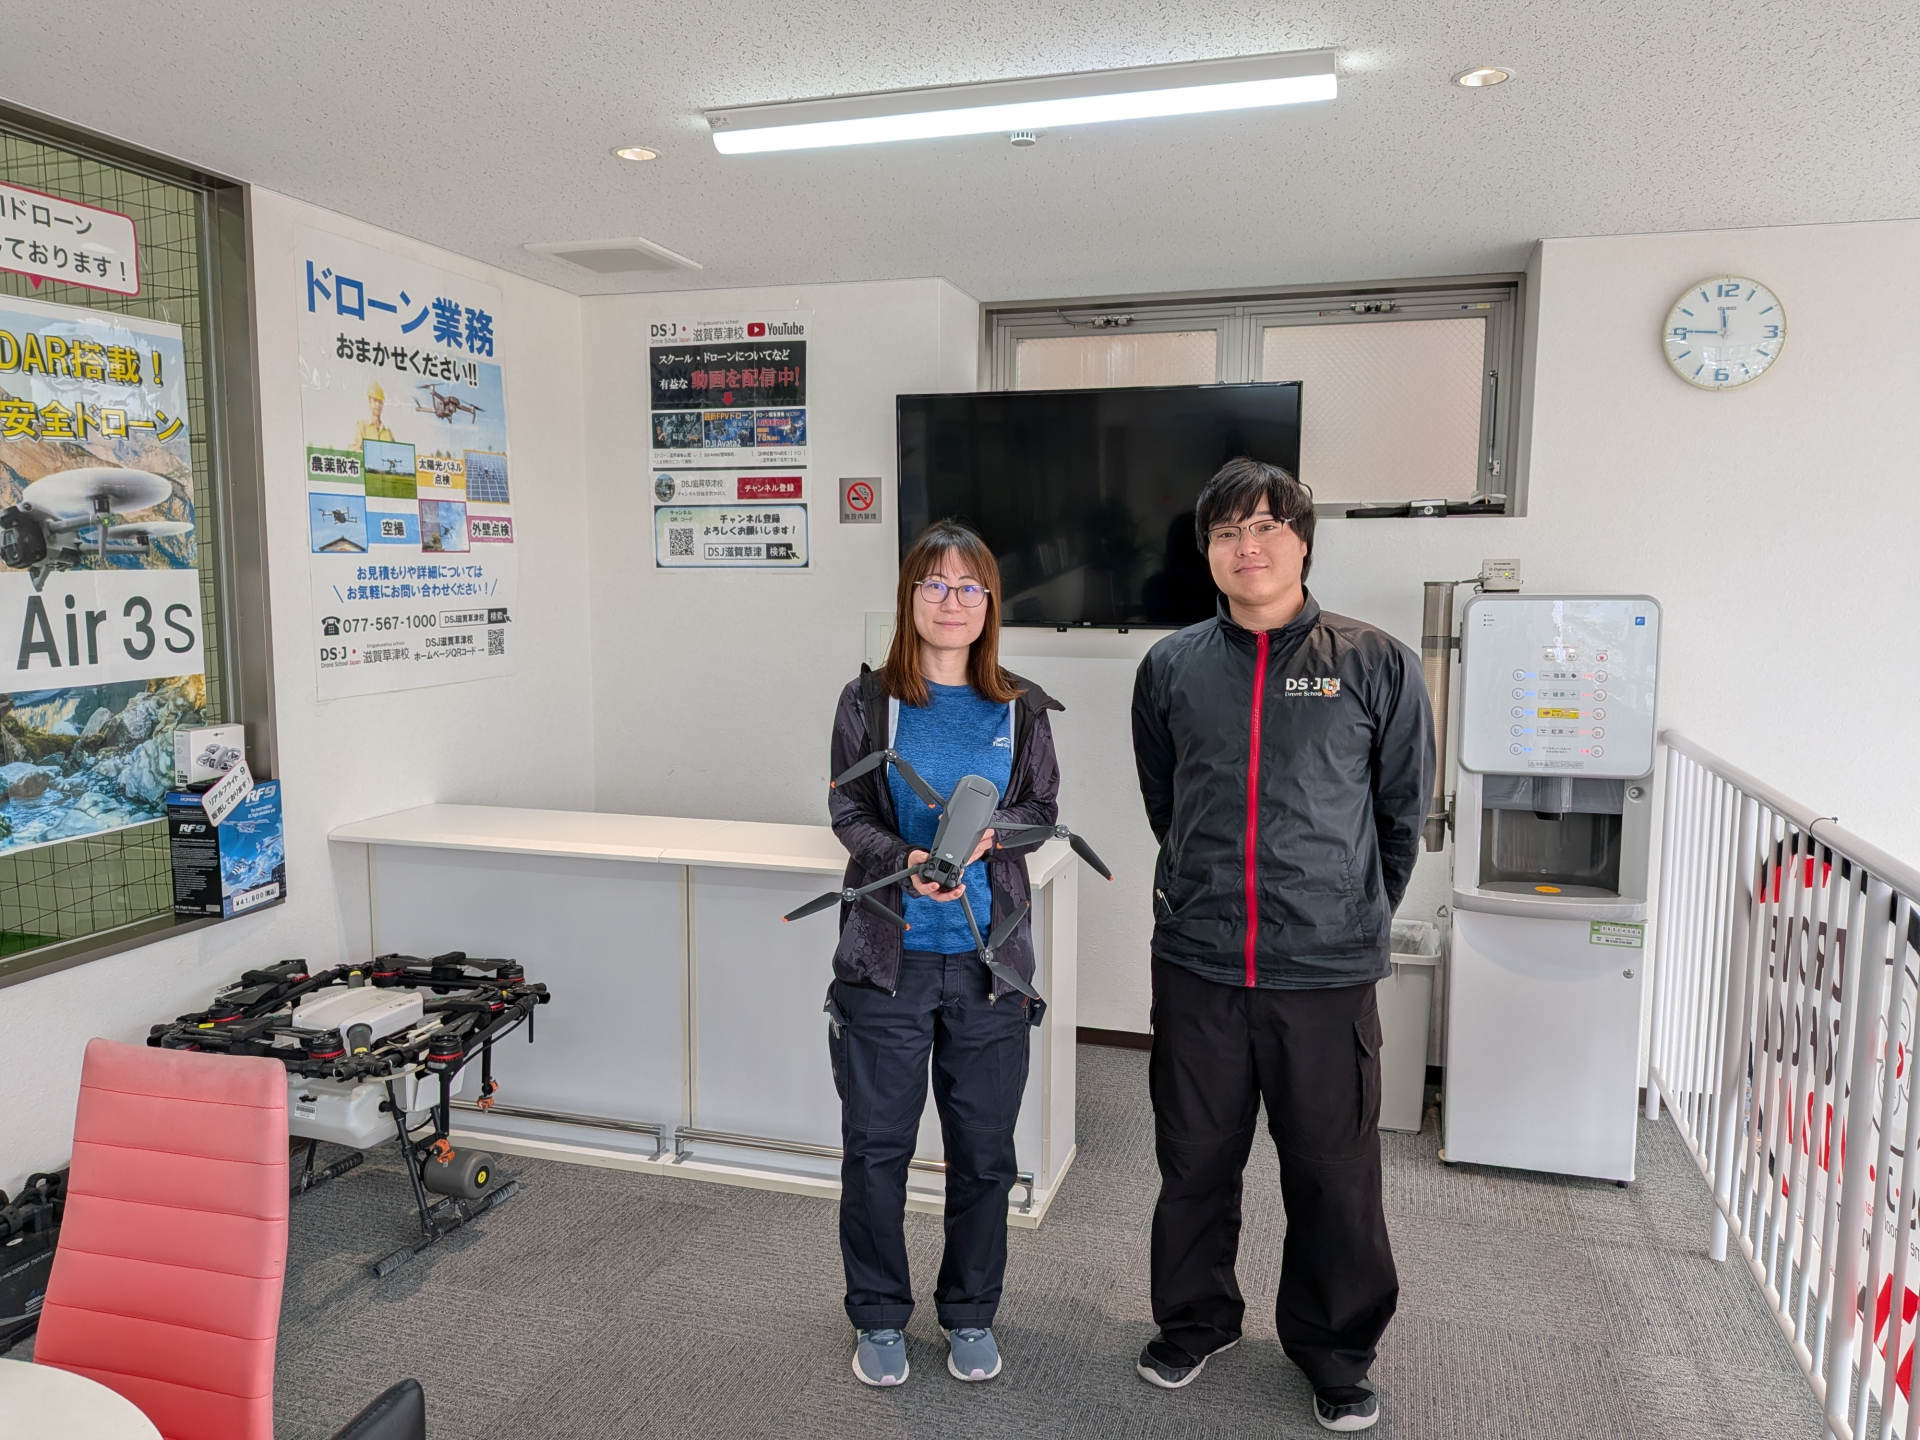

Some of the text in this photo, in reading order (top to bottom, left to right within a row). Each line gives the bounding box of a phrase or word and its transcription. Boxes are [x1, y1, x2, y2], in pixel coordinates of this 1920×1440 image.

[0, 237, 126, 281] ております！
[1716, 284, 1740, 297] 12
[306, 260, 494, 358] ドローン業務
[693, 326, 745, 342] 滋賀草津校
[767, 322, 804, 336] YouTube
[1763, 325, 1779, 339] 3
[658, 349, 790, 365] スクール・ドローンについてなど
[1714, 368, 1730, 381] 6
[659, 378, 688, 390] 有益な
[311, 456, 360, 475] 農薬散布
[418, 459, 463, 472] 太陽光パネル
[434, 475, 451, 485] 点検
[681, 479, 724, 488] DSJ滋賀草津校
[744, 484, 795, 493] チャンネル登録
[720, 514, 780, 524] チャンネル登録
[382, 520, 405, 536] 空撮
[472, 523, 510, 537] 外壁点検
[703, 525, 796, 536] よろしくお願いします！
[707, 546, 787, 557] DSJ滋賀草津 検索
[357, 565, 483, 580] お見積もりや詳細については
[346, 582, 488, 600] お気軽にお問い合わせください！
[343, 614, 436, 633] 077-567-1000
[444, 611, 504, 624] DSJ滋賀草津校 検索
[17, 594, 107, 670] Air
[425, 634, 474, 648] DSJ滋賀草津校
[362, 647, 410, 664] 滋賀草津校
[321, 661, 334, 669] Drone
[245, 785, 276, 803] RF9
[179, 824, 206, 833] RF9
